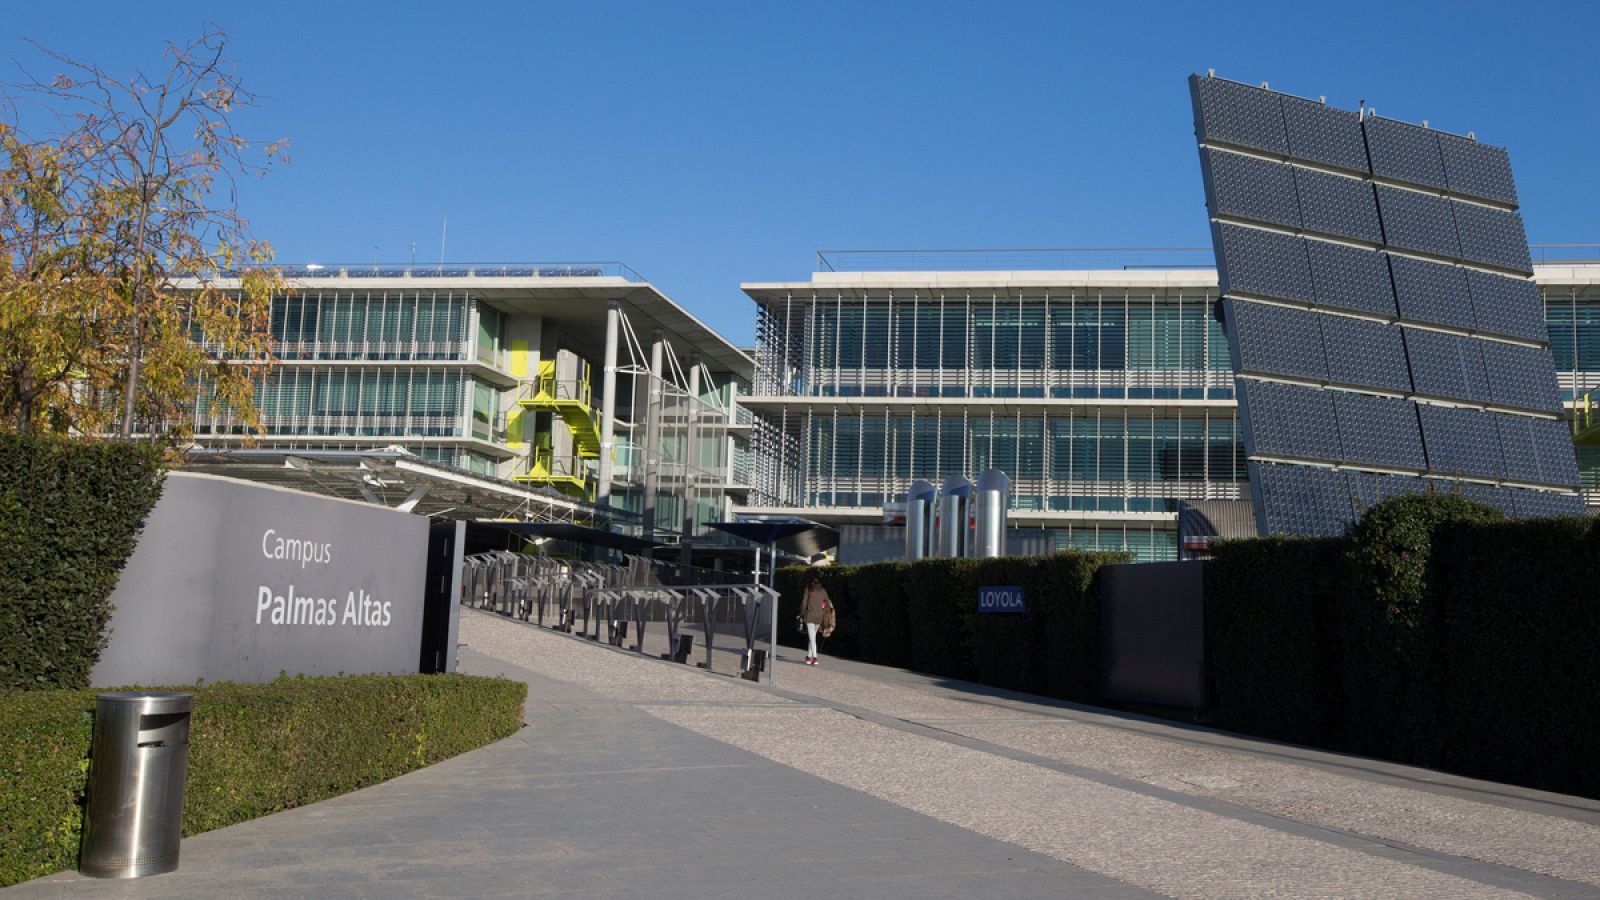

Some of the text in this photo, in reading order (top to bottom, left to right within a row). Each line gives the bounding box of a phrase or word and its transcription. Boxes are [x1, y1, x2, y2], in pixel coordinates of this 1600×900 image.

[262, 529, 332, 568] Campus
[255, 585, 392, 626] Palmas Altas
[980, 591, 1024, 608] LOYOLA
